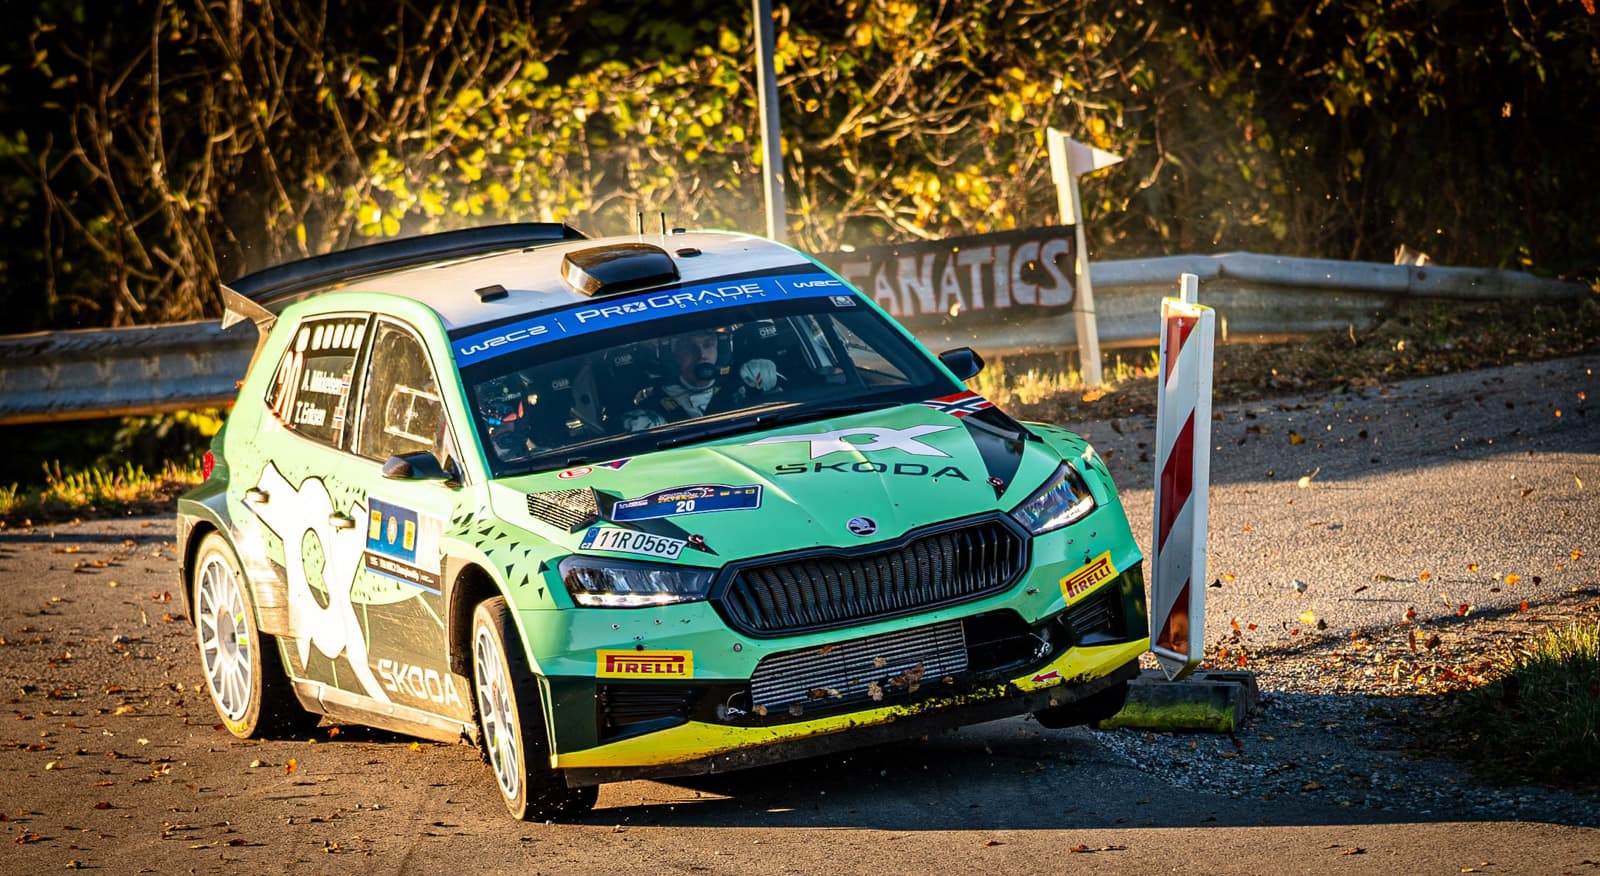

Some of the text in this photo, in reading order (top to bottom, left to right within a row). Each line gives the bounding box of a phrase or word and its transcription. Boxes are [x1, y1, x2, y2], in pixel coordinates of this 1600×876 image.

[842, 238, 1073, 317] FANATICS
[679, 293, 767, 309] DIGITAL
[460, 325, 549, 356] WRC2
[675, 499, 696, 513] 20
[1065, 557, 1112, 598] PIRELLI
[605, 655, 685, 674] PIRELLI
